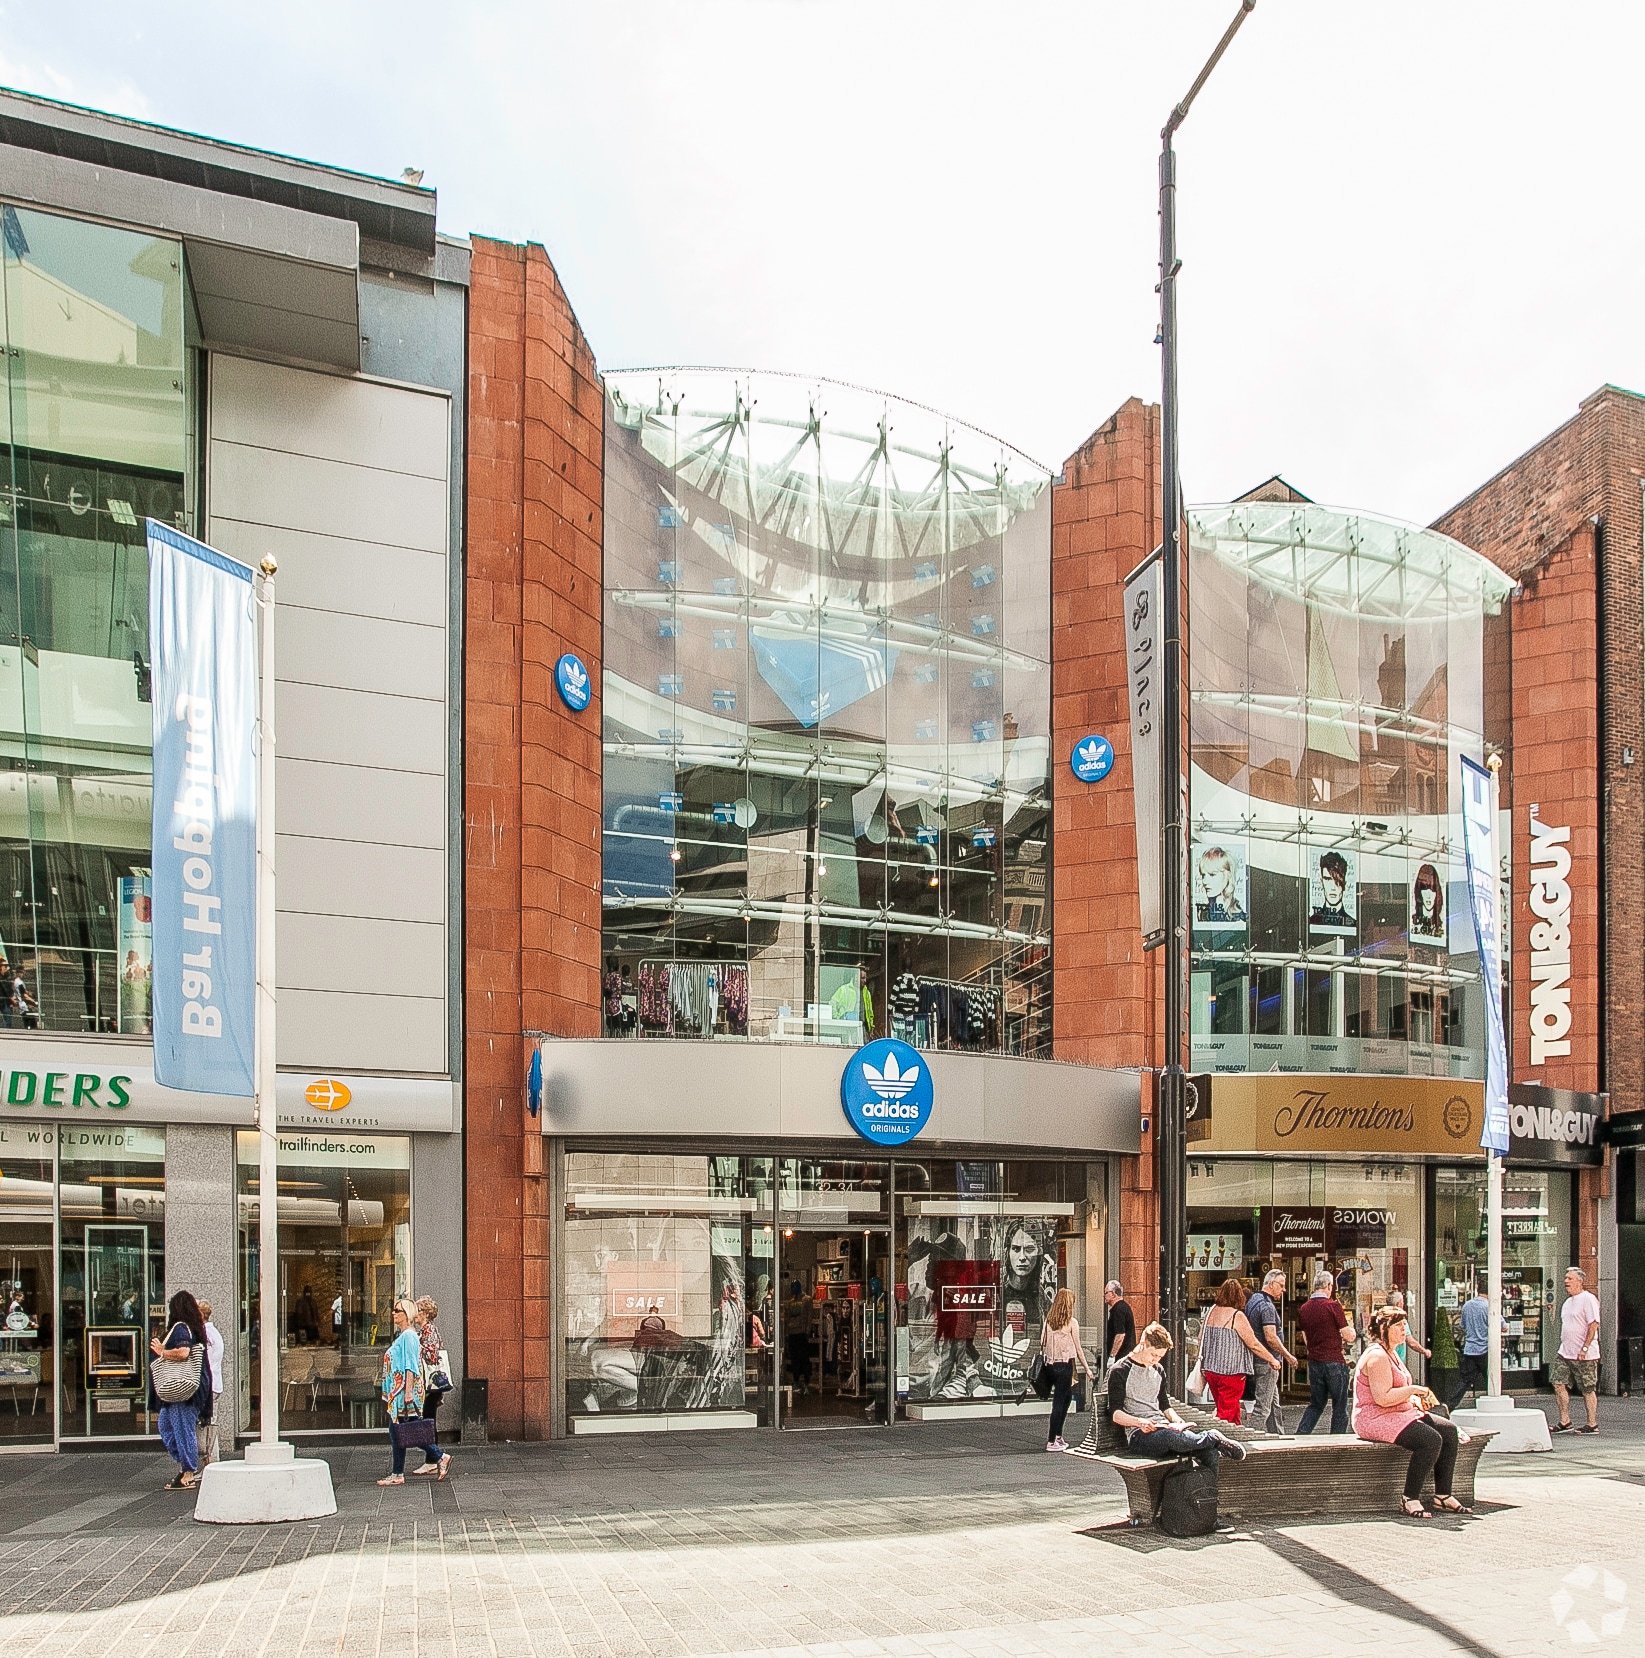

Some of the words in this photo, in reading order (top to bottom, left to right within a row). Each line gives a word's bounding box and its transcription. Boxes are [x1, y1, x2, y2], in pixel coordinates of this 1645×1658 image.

[564, 683, 586, 701] adidas
[1078, 760, 1107, 771] adidas
[1529, 819, 1572, 1066] TONI&GUY
[1253, 1042, 1283, 1051] TONI&GUY
[1310, 1044, 1338, 1052] TONI&GUY
[1215, 1064, 1247, 1072] TONI&GUY
[0, 1070, 133, 1109] DERS
[862, 1100, 919, 1119] adidas
[1273, 1089, 1416, 1138] Thorntons
[278, 1115, 295, 1123] THE
[301, 1115, 335, 1124] TRAVEL
[340, 1117, 380, 1126] EXPERTS
[870, 1124, 911, 1134] ORIGINALS
[27, 1131, 135, 1146] WORLDWIDE
[279, 1137, 376, 1154] trailfinders.com
[1273, 1213, 1325, 1233] Thorntons
[1501, 1270, 1522, 1280] abel.m
[626, 1296, 666, 1308] SALE
[952, 1292, 987, 1304] SALE
